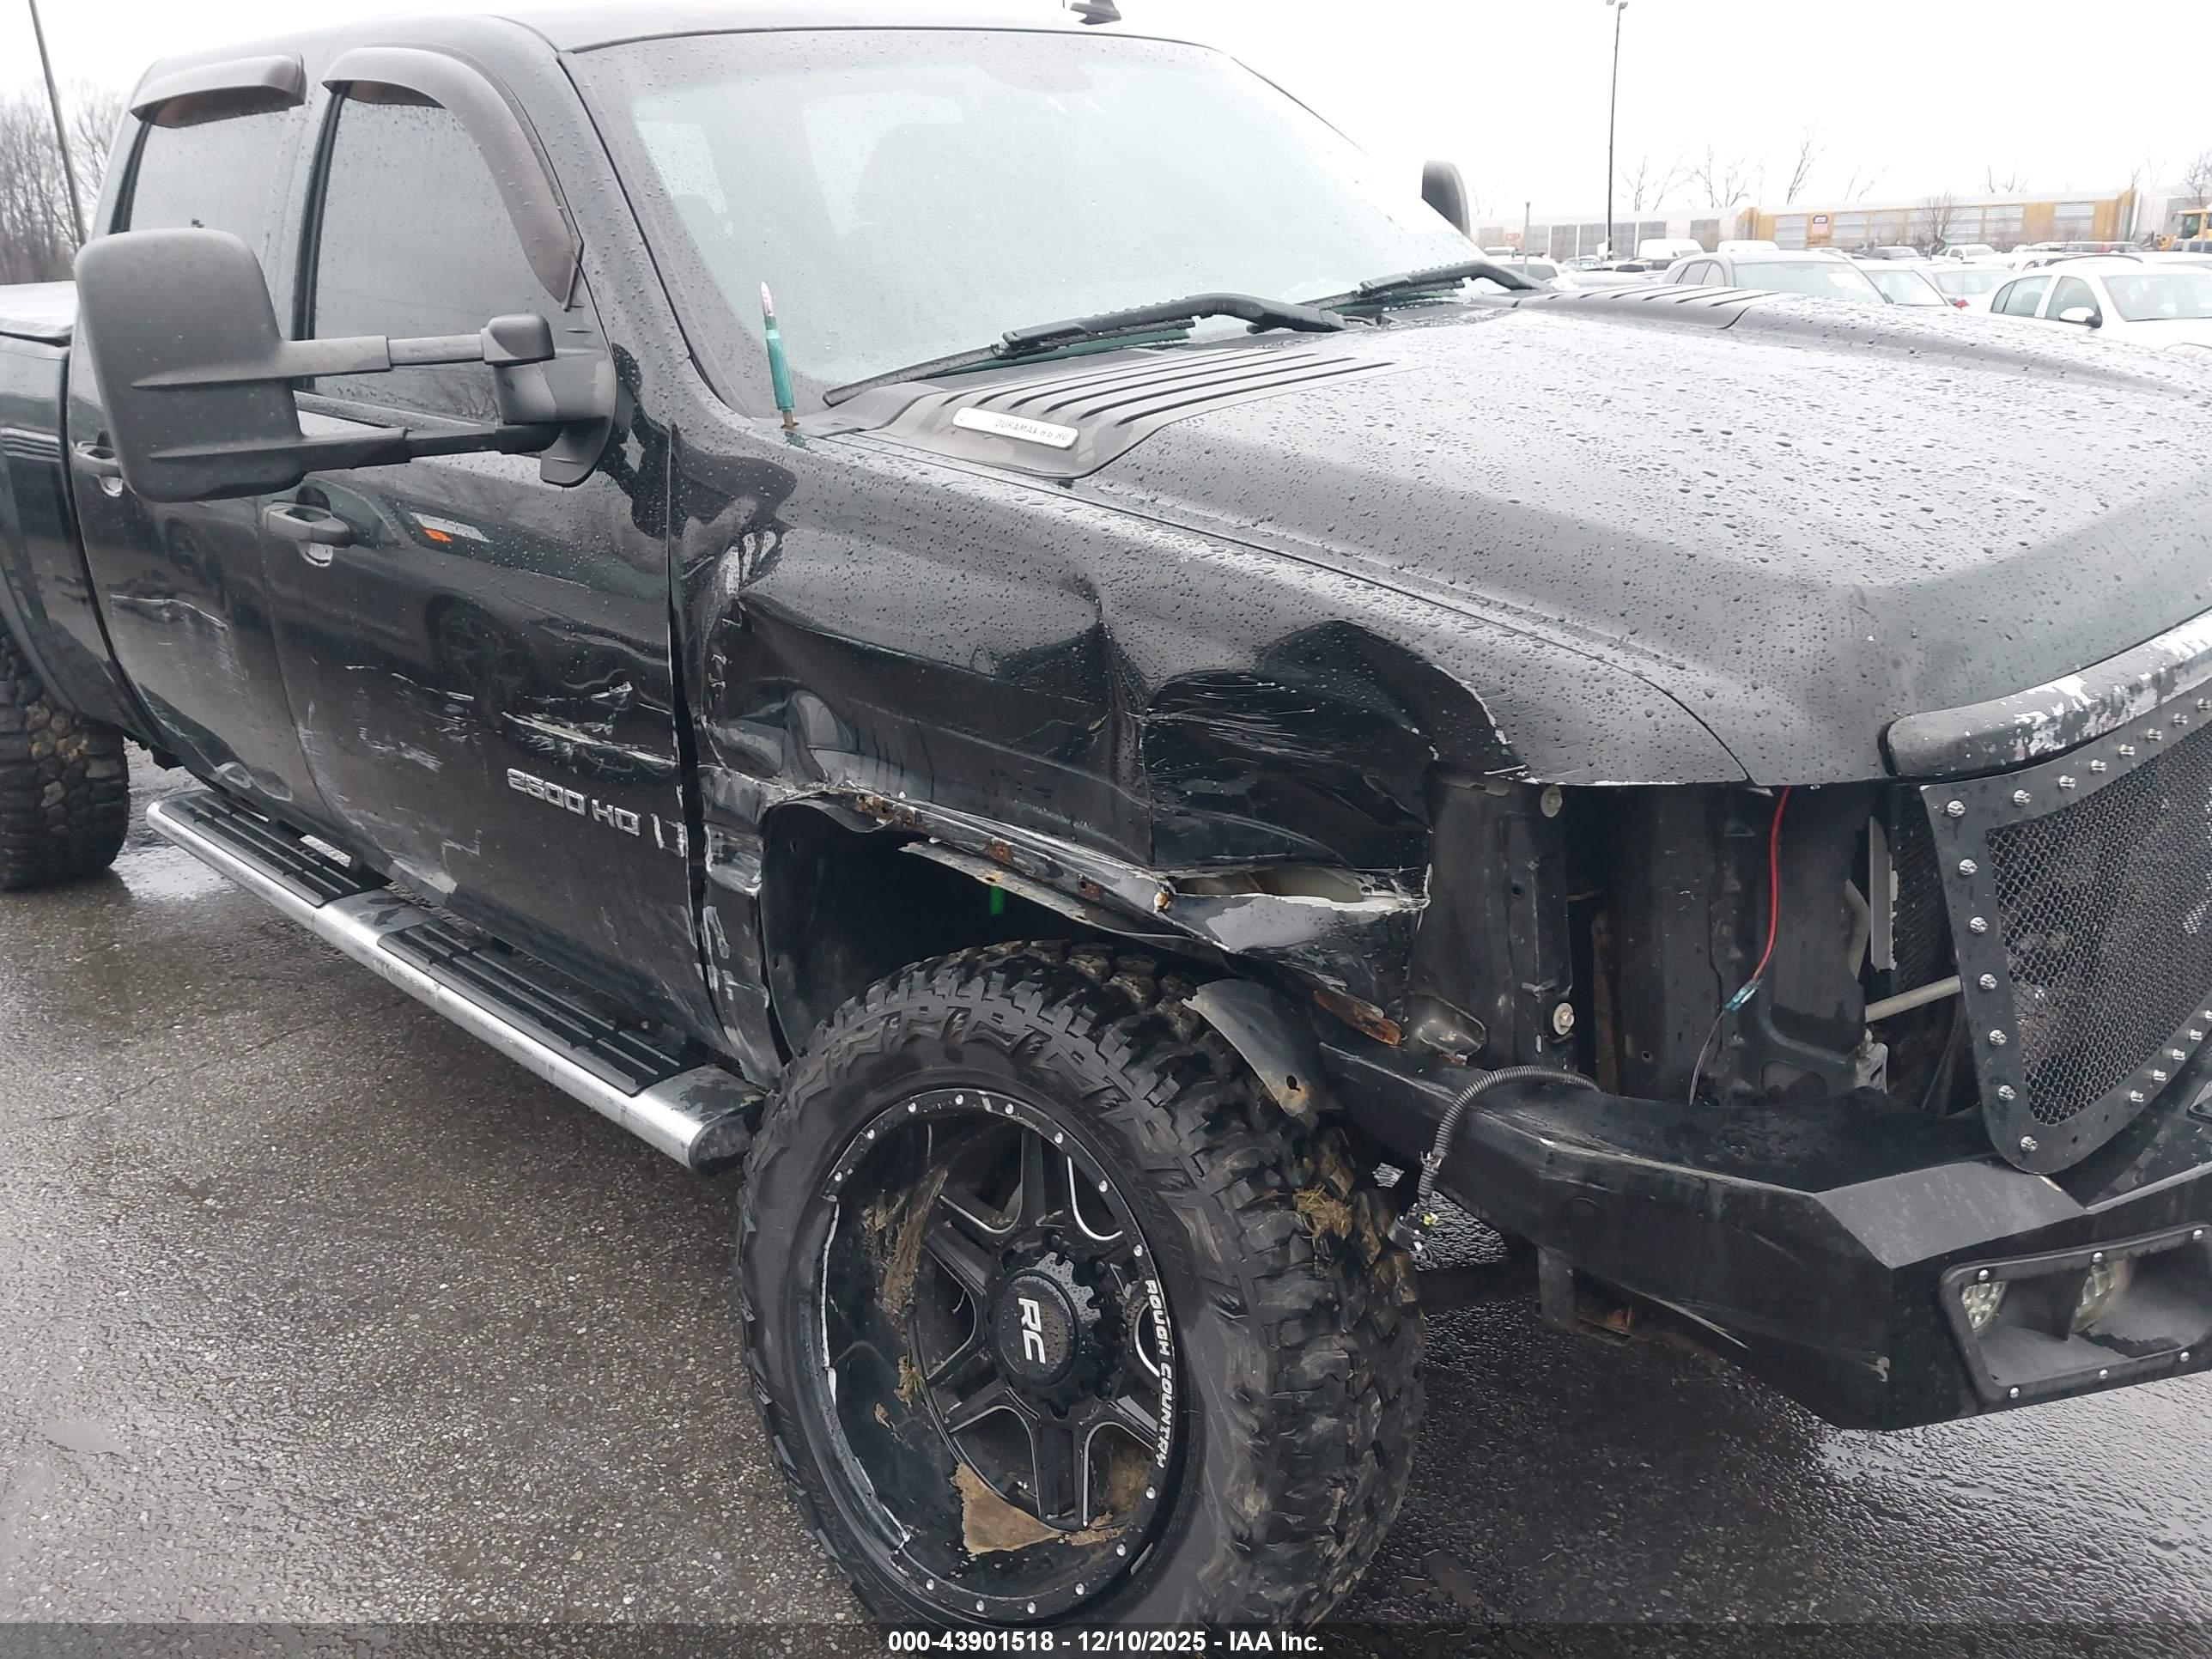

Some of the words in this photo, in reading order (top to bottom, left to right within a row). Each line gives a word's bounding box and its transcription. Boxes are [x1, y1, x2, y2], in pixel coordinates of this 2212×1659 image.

[507, 768, 586, 816] 2500
[591, 799, 641, 836] HD
[1018, 1297, 1046, 1364] RC
[1145, 1279, 1170, 1356] ROUGH
[1156, 1362, 1173, 1468] COUNTRY
